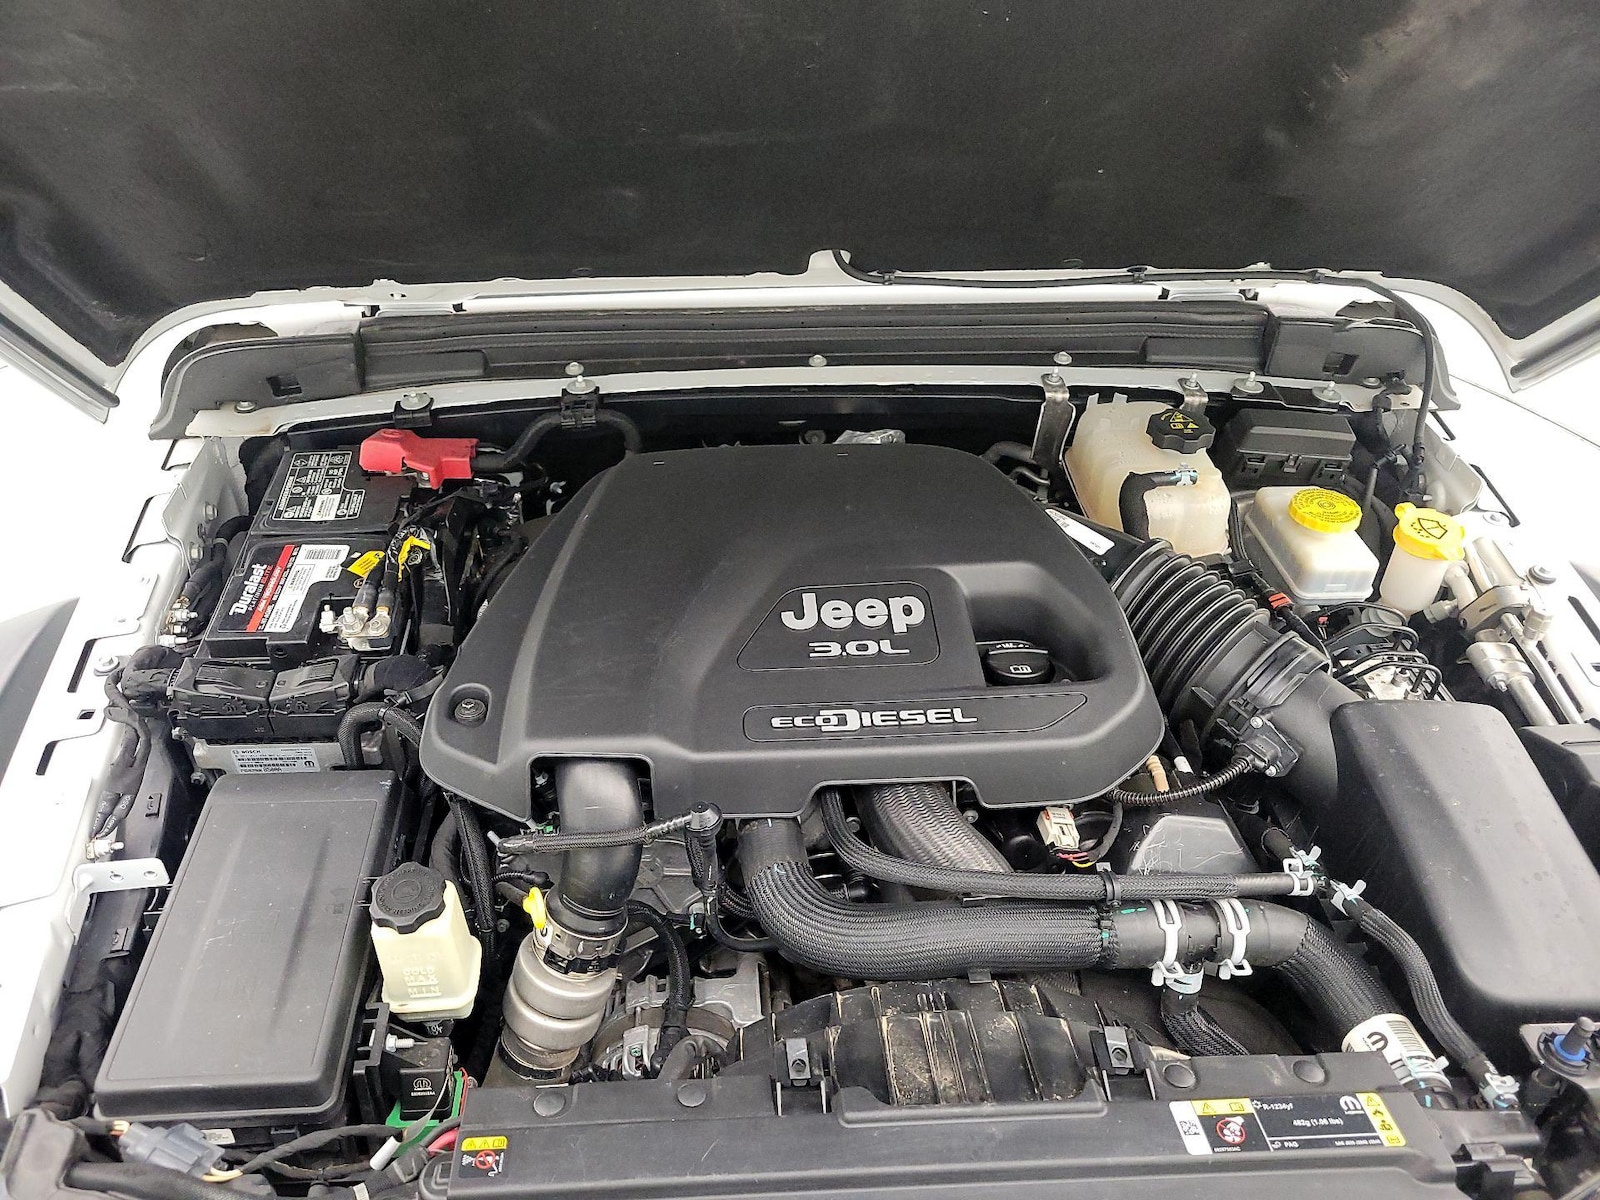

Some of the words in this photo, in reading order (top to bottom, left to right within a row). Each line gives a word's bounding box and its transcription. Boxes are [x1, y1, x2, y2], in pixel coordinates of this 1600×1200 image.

[228, 563, 268, 616] Duralast
[781, 592, 926, 634] Jeep
[808, 639, 911, 659] 3.0L
[1283, 1141, 1299, 1149] PAG
